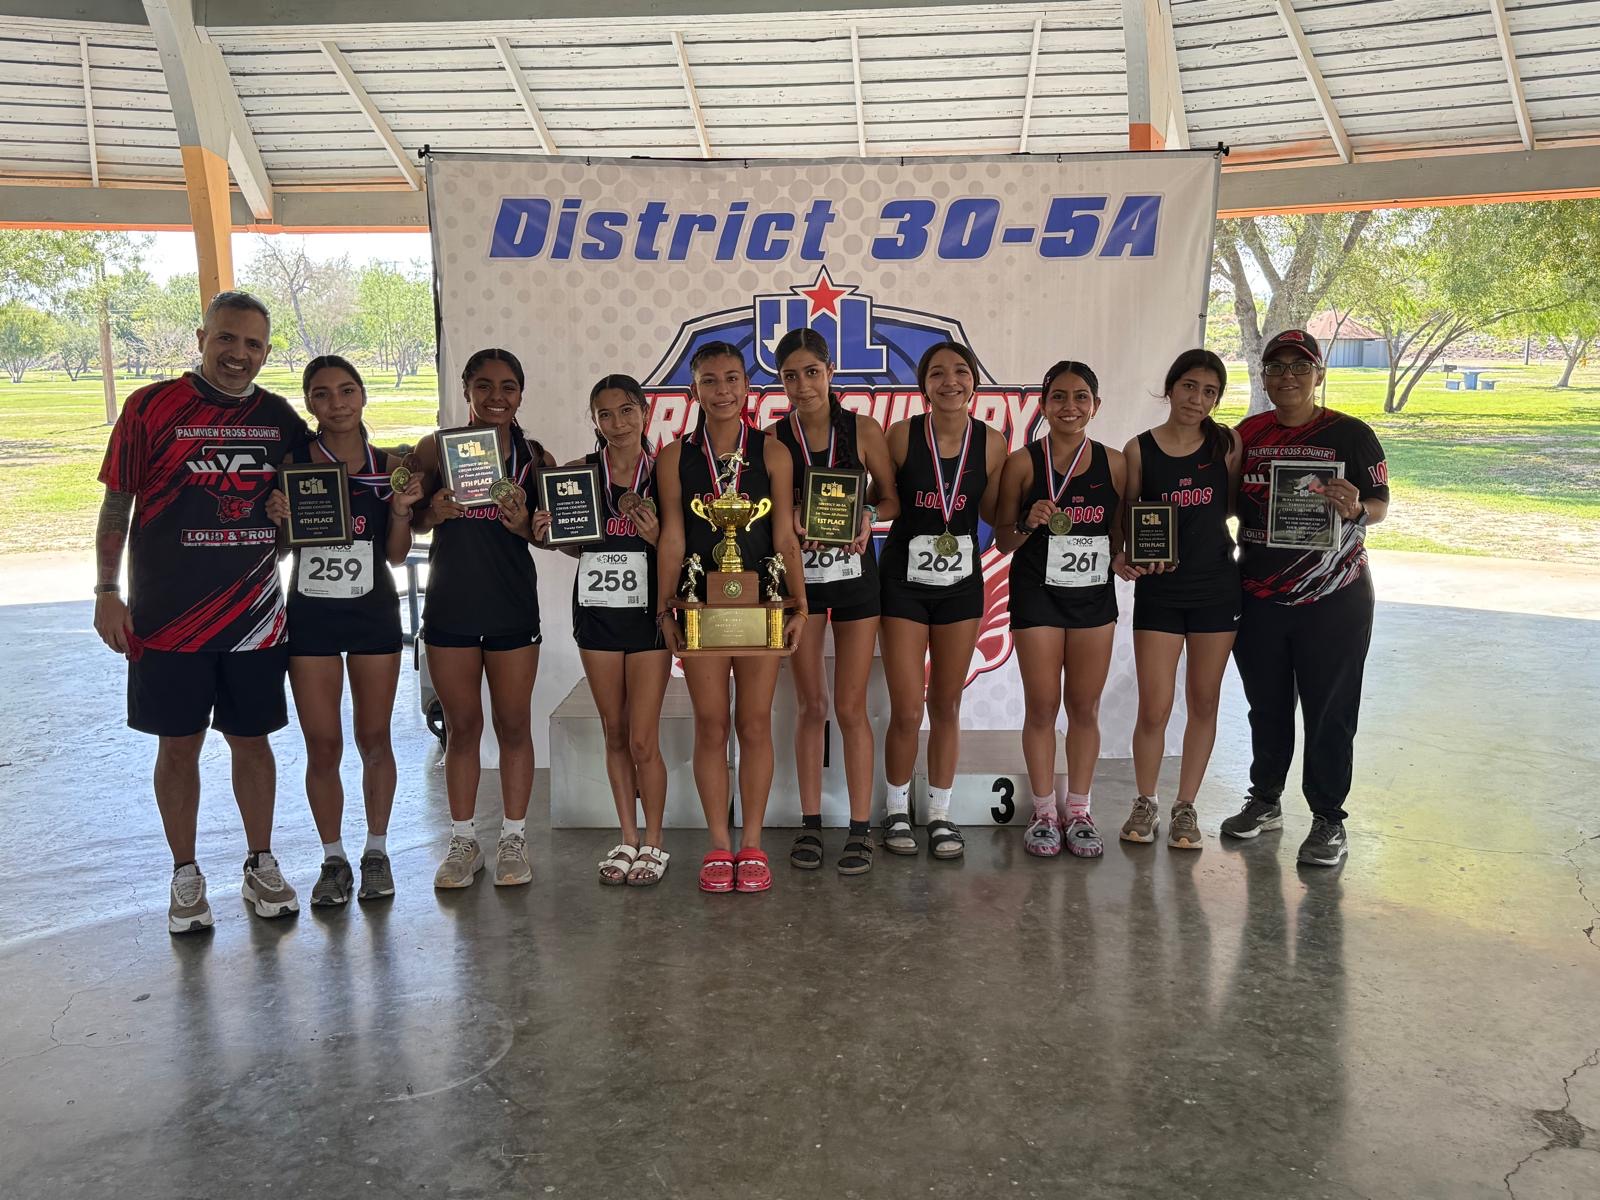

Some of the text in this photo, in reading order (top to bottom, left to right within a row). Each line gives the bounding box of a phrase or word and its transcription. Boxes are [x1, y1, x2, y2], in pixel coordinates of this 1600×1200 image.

[488, 195, 1162, 261] District 30-5A
[178, 428, 279, 438] PALMVIEW CROSS COUNTRY
[1280, 447, 1301, 456] CROSS
[1302, 448, 1334, 459] COUNTRY
[299, 477, 328, 495] UIL
[474, 478, 493, 486] PLACE
[556, 478, 582, 496] UIL
[821, 481, 846, 498] UIL
[313, 516, 333, 524] PLACE
[187, 531, 224, 541] LOUD
[228, 531, 237, 541] &
[308, 556, 363, 582] 259
[918, 551, 963, 572] 262
[1060, 552, 1098, 573] 261
[587, 569, 638, 592] 258
[990, 777, 1016, 824] 3
